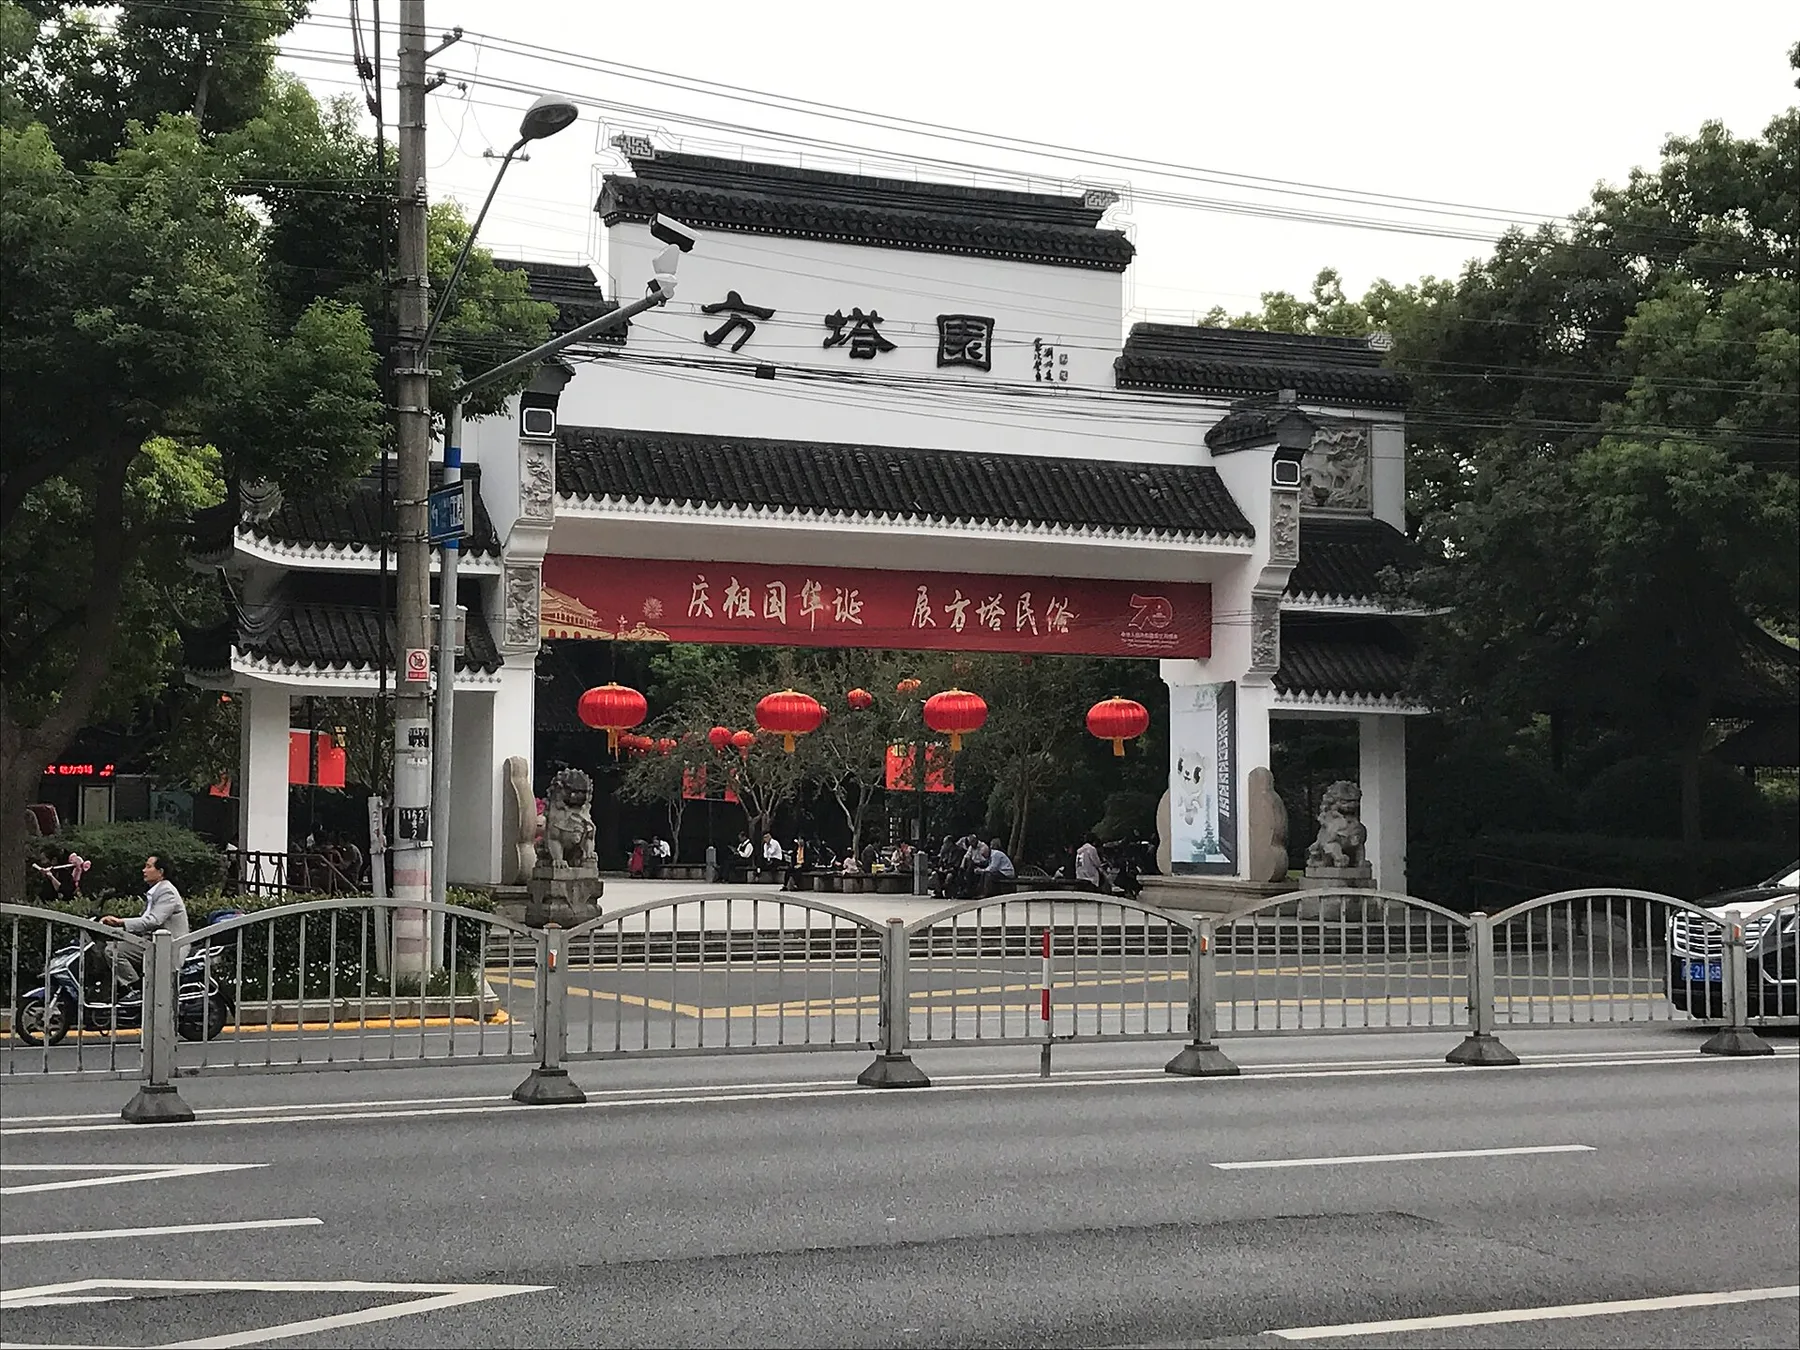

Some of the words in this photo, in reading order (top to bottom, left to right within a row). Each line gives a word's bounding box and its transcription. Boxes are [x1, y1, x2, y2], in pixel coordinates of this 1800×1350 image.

[687, 575, 864, 632] 庆祖国华诞
[911, 585, 1081, 636] 展方塔民俗
